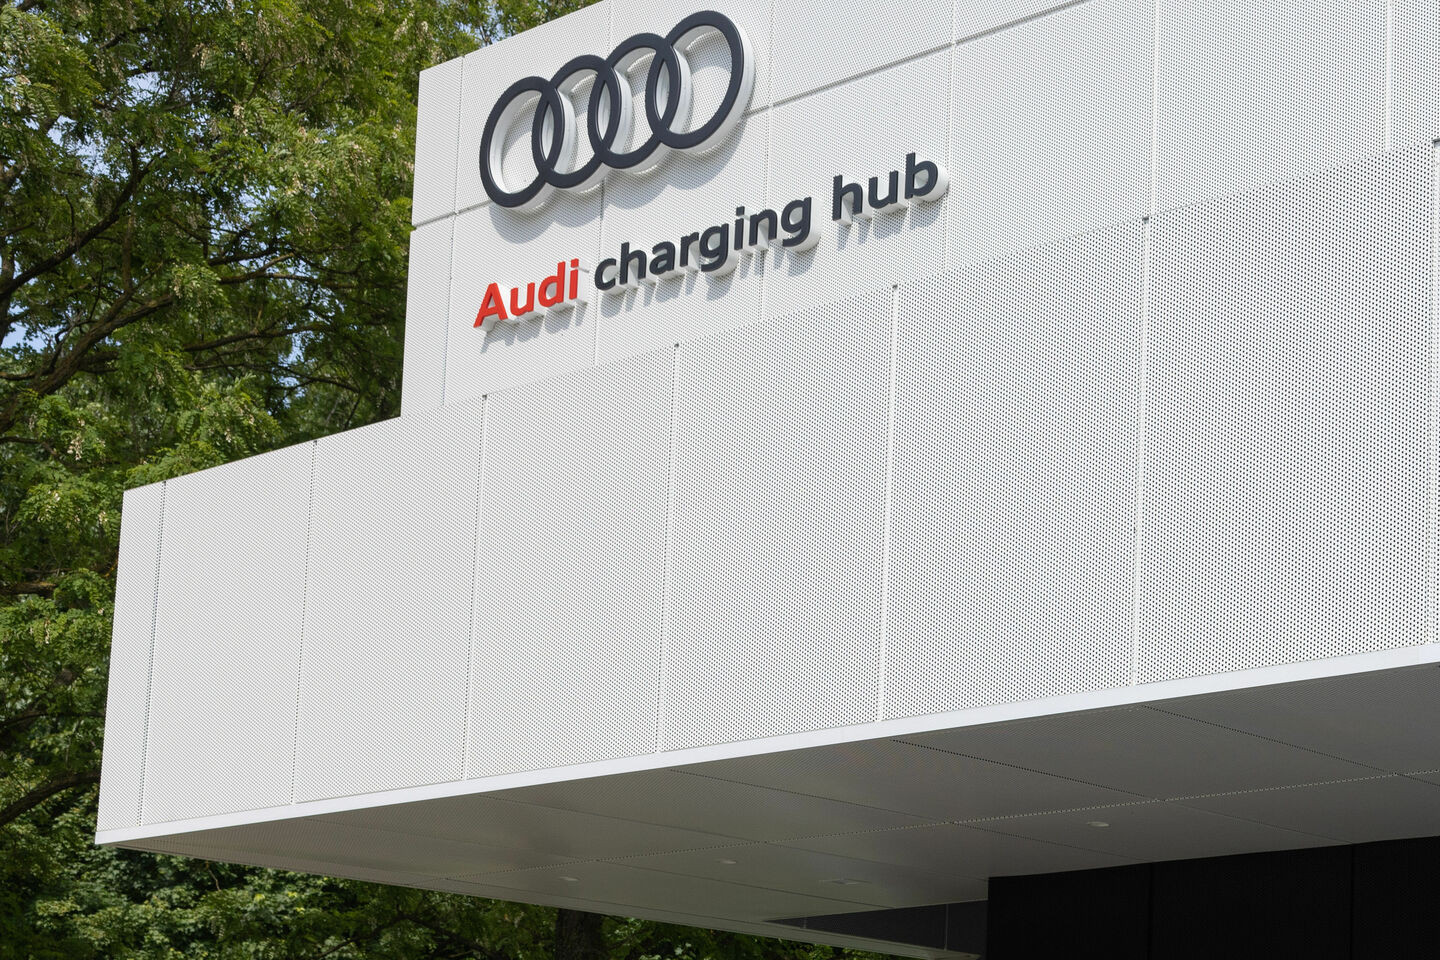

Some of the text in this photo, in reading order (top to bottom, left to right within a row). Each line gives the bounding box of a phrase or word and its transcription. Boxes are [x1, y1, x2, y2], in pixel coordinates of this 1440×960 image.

[474, 152, 941, 329] Audi charging hub
